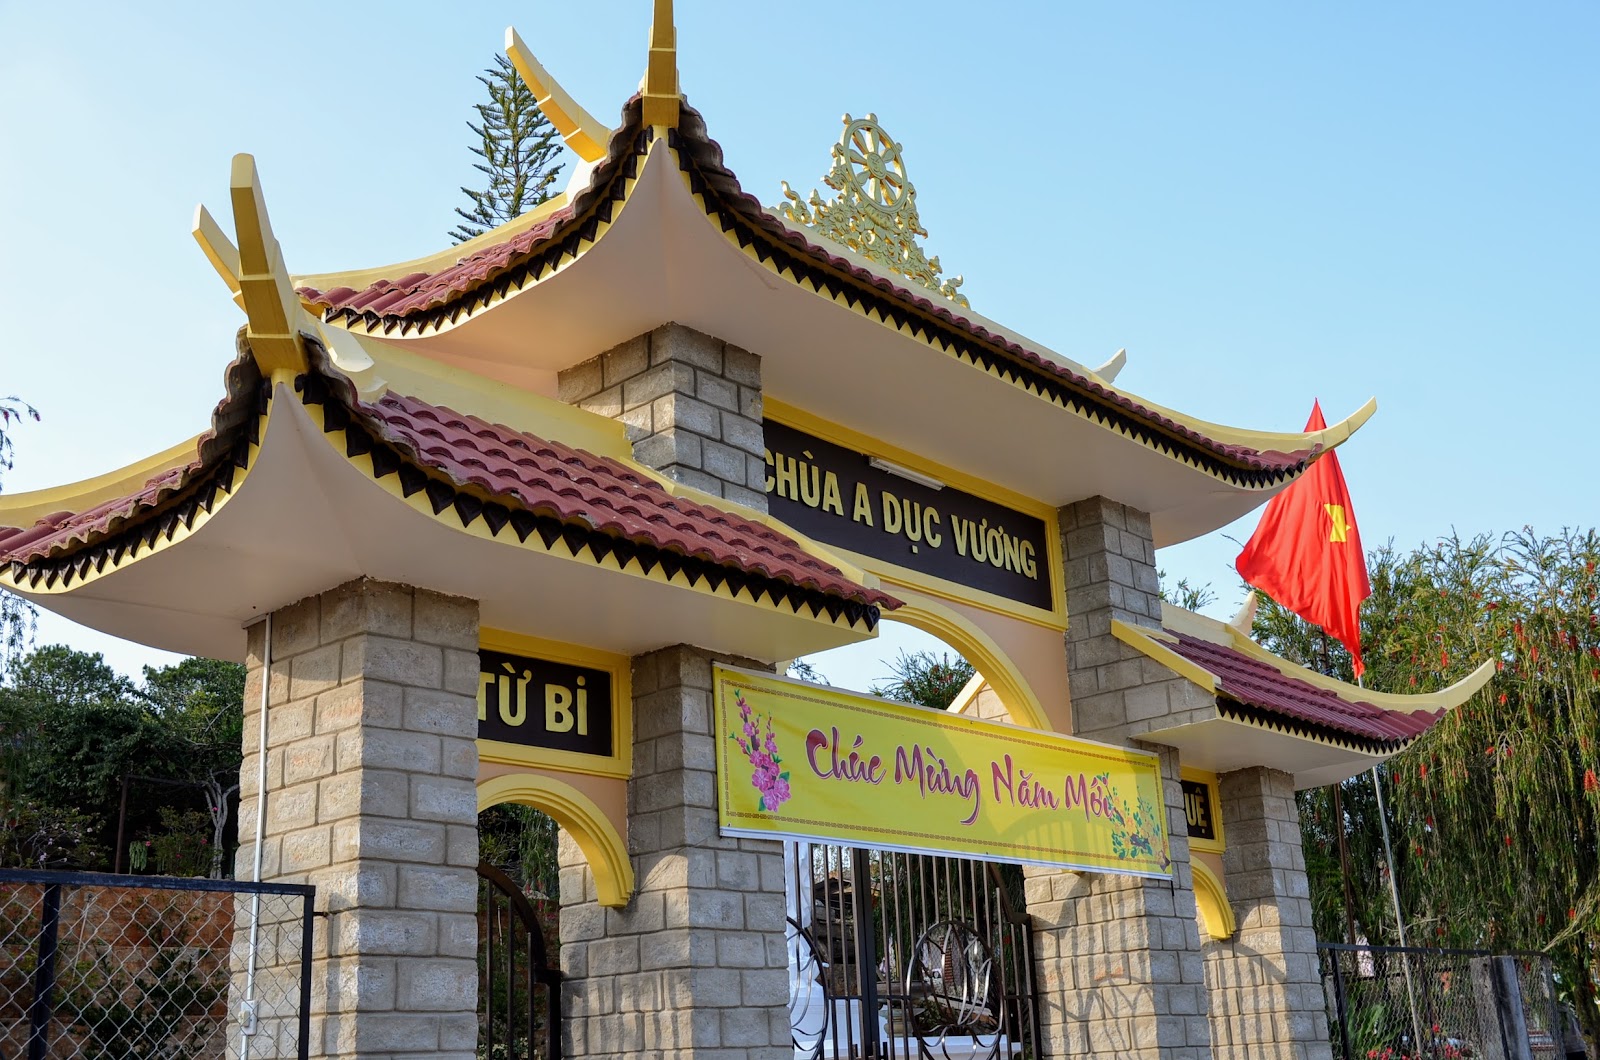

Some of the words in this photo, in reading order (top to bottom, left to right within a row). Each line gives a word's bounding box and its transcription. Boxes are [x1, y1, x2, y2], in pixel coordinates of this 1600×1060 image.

[764, 448, 845, 517] CHÙA
[853, 481, 874, 528] A
[882, 491, 943, 554] DỤC
[951, 516, 1038, 581] VƯƠNG
[478, 662, 532, 727] TỪ
[805, 725, 887, 786] Chúc
[894, 743, 981, 826] Mừng
[991, 753, 1061, 811] Năm
[1065, 772, 1114, 823] Mới
[1183, 786, 1208, 835] UỆ
